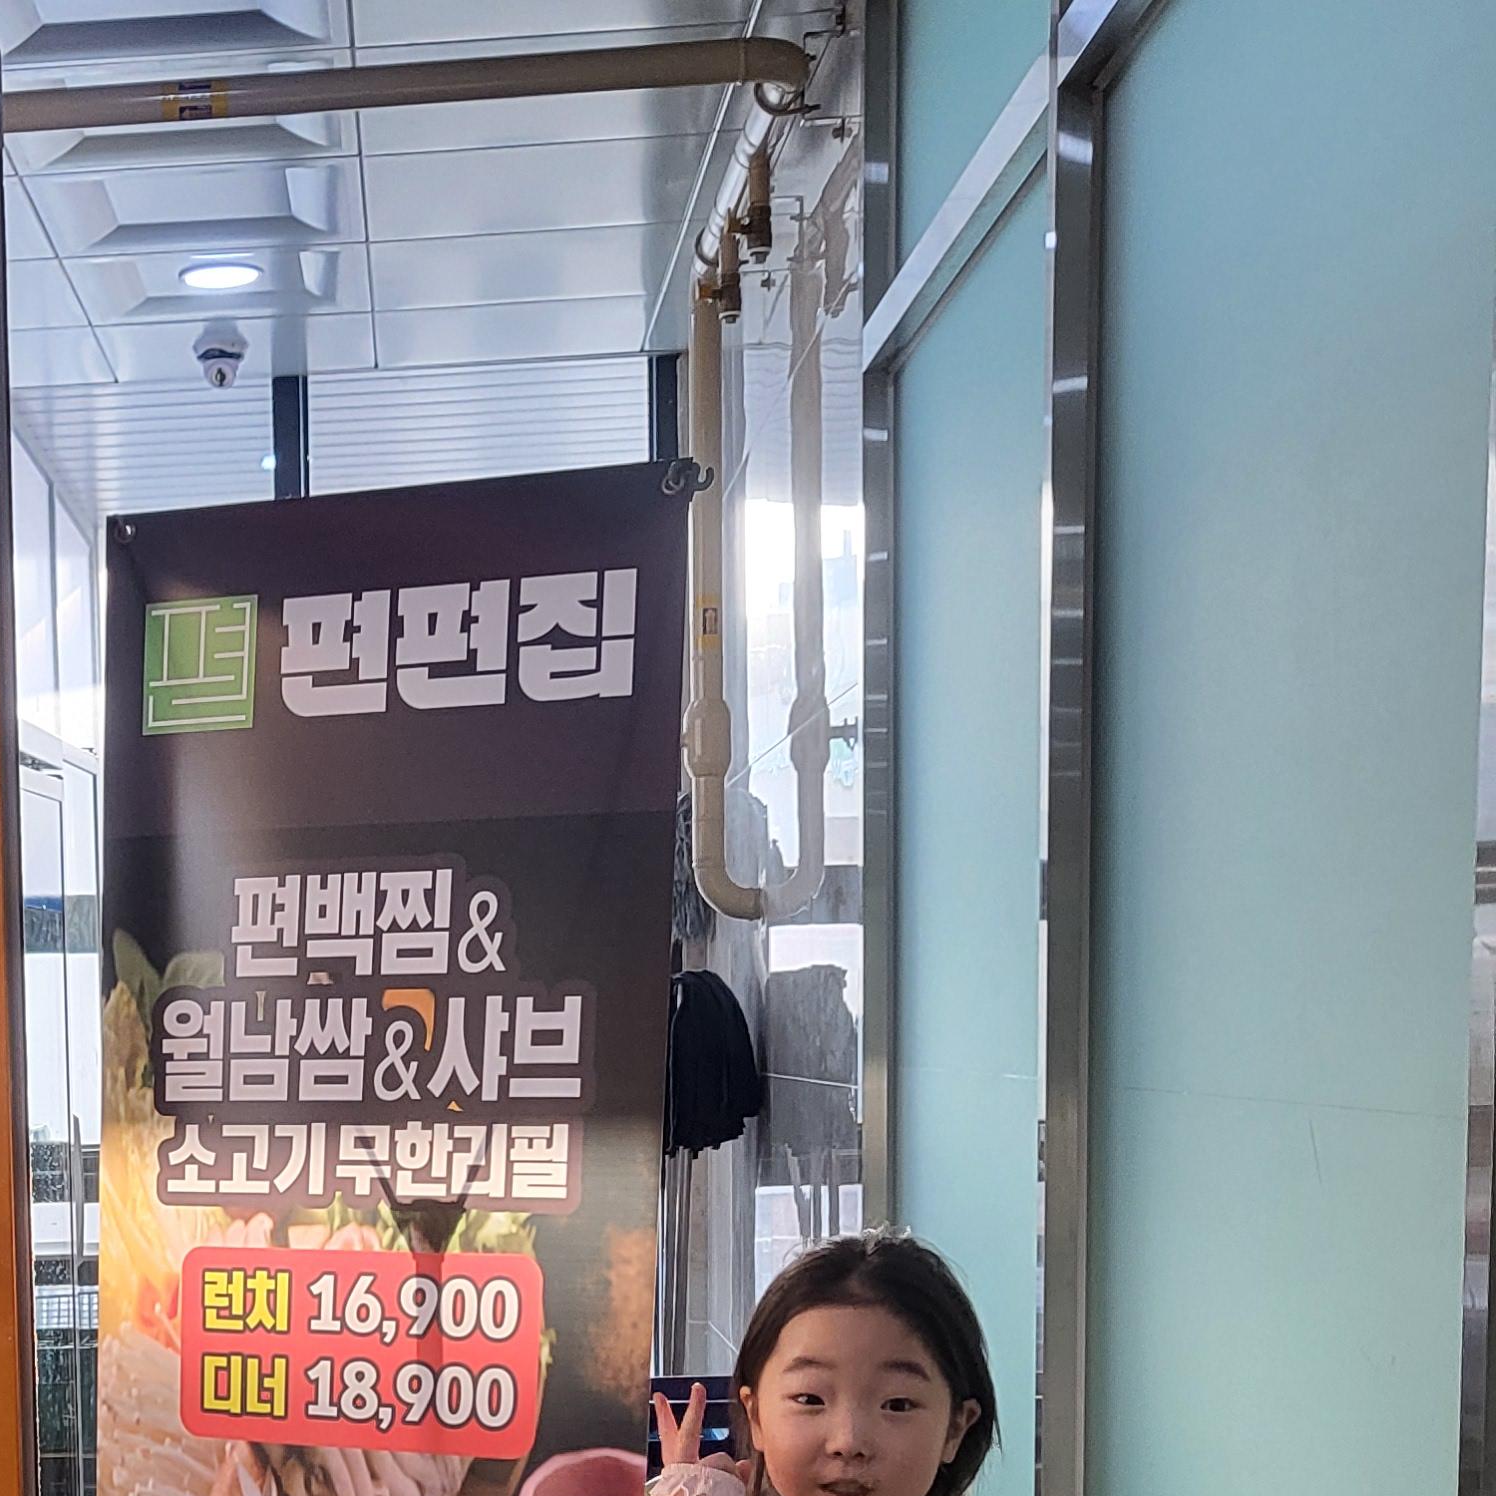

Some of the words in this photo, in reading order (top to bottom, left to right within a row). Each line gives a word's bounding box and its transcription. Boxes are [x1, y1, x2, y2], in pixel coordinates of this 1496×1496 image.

[280, 568, 637, 717] 편편집
[335, 1121, 570, 1200] 무한리필
[203, 1269, 290, 1333] 런치
[307, 1273, 520, 1344] 16,900
[202, 1354, 288, 1418] 디너
[305, 1359, 515, 1430] 18,900
